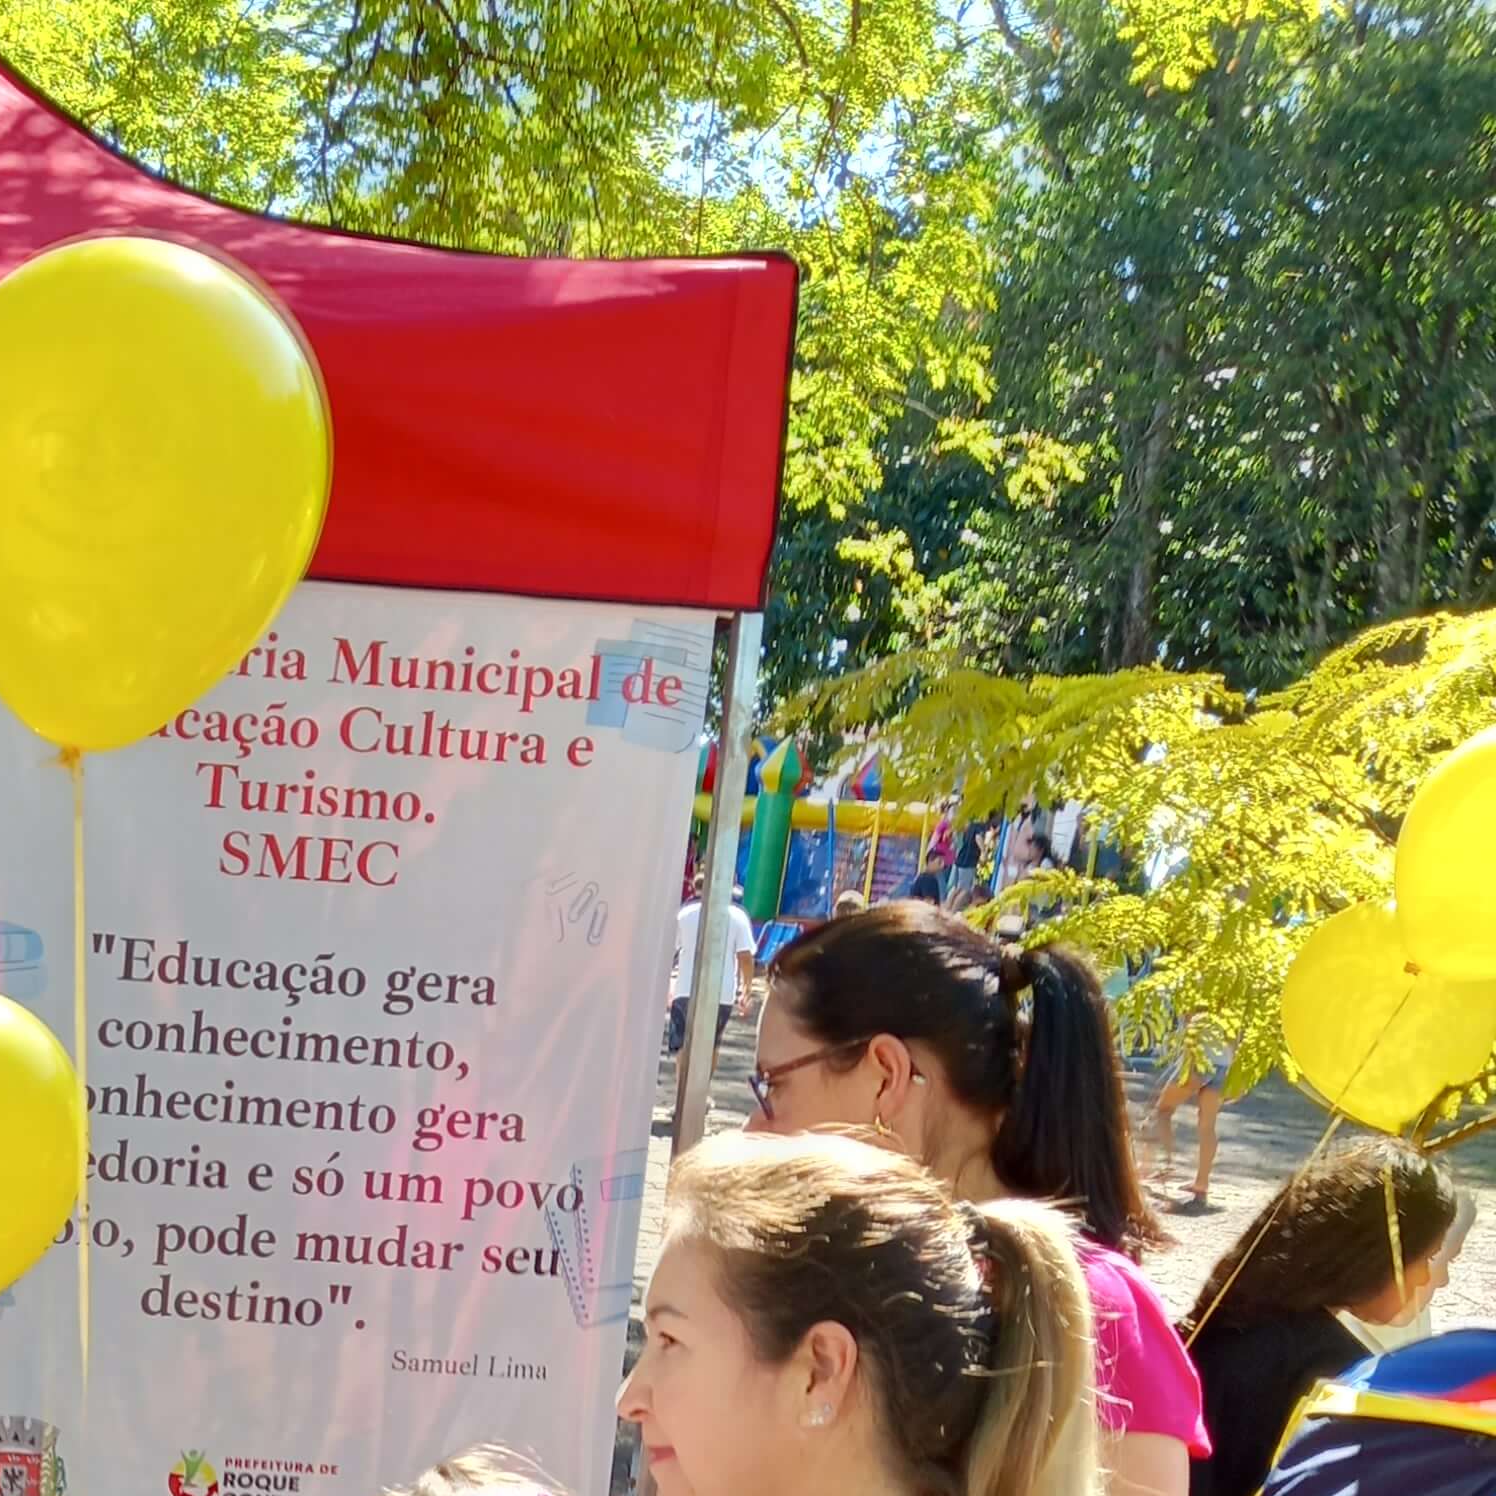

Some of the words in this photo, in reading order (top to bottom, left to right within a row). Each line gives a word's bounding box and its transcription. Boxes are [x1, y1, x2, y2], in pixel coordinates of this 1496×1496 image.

[327, 636, 602, 712] Municipal
[621, 656, 684, 707] de
[149, 701, 320, 759] cação
[338, 706, 549, 764] Cultura
[565, 736, 595, 767] e
[195, 762, 437, 823] Turismo.
[219, 831, 401, 887] SMEC
[90, 932, 369, 1010] "Educação
[383, 963, 497, 1015] gera
[97, 1009, 471, 1080] conhecimento,
[413, 1102, 526, 1150] gera
[247, 1163, 274, 1193] e
[291, 1152, 345, 1198] só
[364, 1172, 443, 1206] um
[462, 1172, 585, 1220] povo
[153, 1213, 277, 1265] pode
[295, 1222, 464, 1274] mudar
[482, 1244, 562, 1278] seu
[141, 1275, 367, 1331] destino".
[391, 1350, 480, 1377] Samuel
[488, 1356, 549, 1381] Lima
[223, 1472, 301, 1493] ROQUE
[225, 1457, 315, 1474] PREFEITURA
[320, 1464, 340, 1476] DE
